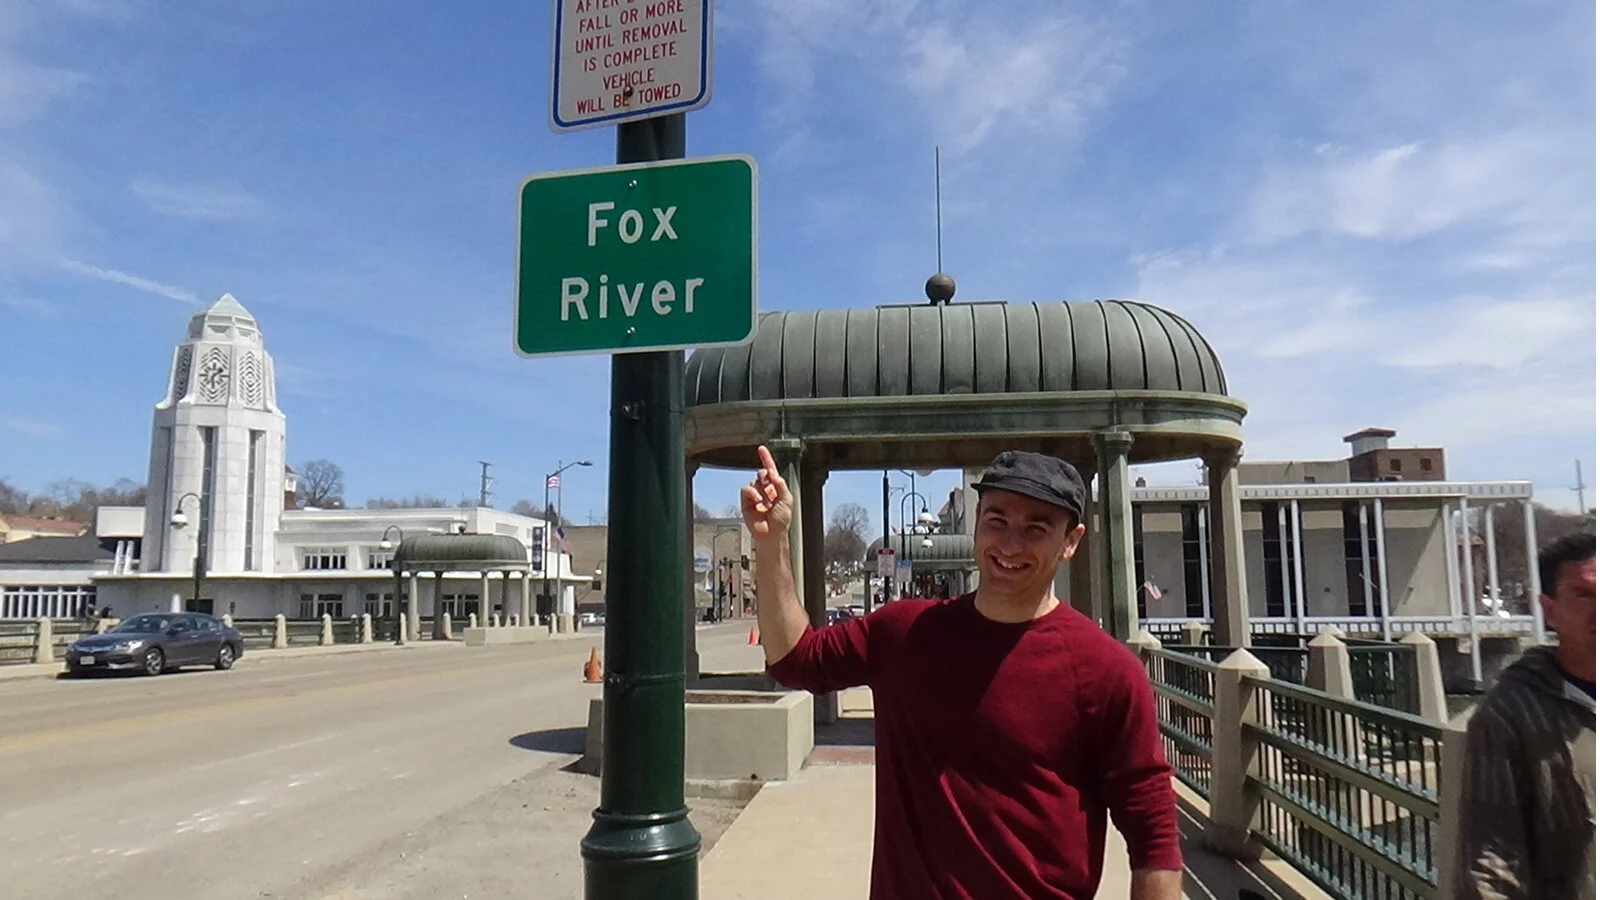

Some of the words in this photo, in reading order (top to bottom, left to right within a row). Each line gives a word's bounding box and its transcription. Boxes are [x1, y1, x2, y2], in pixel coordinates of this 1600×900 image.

[579, 14, 612, 33] FALL
[620, 8, 638, 25] OR
[645, 0, 685, 19] MORE
[575, 34, 615, 54] UNTIL
[622, 18, 687, 44] REMOVAL
[584, 56, 597, 72] IS
[603, 41, 677, 69] COMPLETE
[602, 67, 655, 91] VEHICLE
[576, 97, 605, 115] WILL
[613, 93, 630, 109] BE
[638, 83, 681, 105] TOWED
[588, 201, 678, 246] Fox
[560, 274, 704, 321] River
